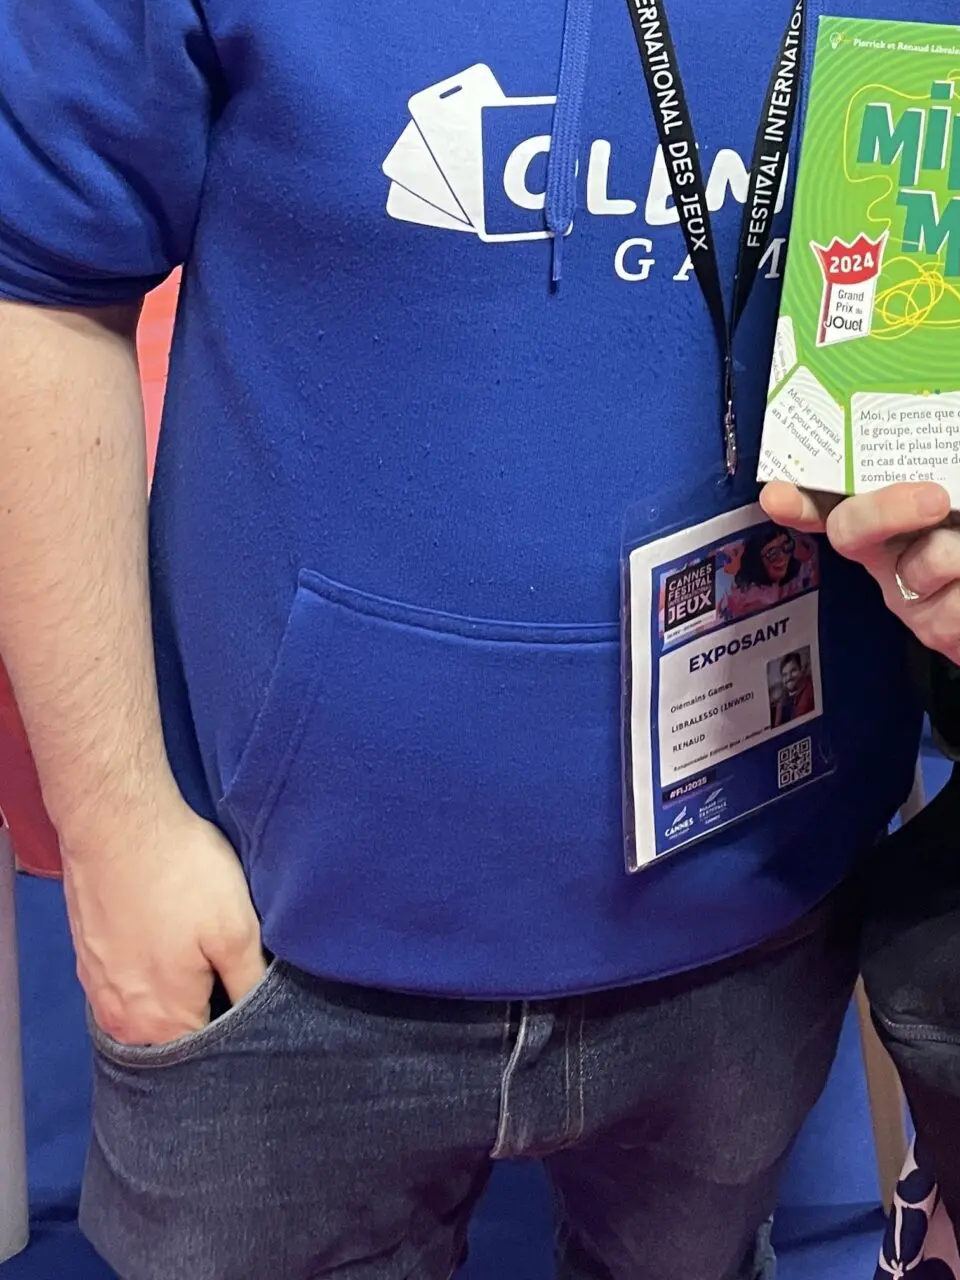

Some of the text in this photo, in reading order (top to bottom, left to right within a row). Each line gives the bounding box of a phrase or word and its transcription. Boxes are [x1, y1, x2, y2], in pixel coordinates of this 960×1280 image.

[669, 141, 695, 187] DES
[747, 151, 780, 247] FESTIVAL
[680, 193, 709, 251] JEUX
[829, 251, 874, 273] 2024
[837, 289, 864, 301] Grand
[836, 301, 853, 313] Prix
[809, 409, 841, 445] payerais
[860, 409, 884, 421] Moi,
[887, 409, 897, 422] je
[899, 410, 932, 423] pense
[934, 410, 955, 423] que
[771, 407, 820, 458] an à Poudlard
[791, 410, 811, 433] pour
[809, 425, 836, 460] étudier
[860, 424, 869, 436] le
[872, 427, 913, 438] groupe,
[916, 423, 942, 435] celui
[860, 440, 893, 451] survit
[896, 439, 906, 450] le
[908, 439, 932, 453] plus
[770, 455, 782, 468] un
[861, 457, 874, 467] en
[877, 456, 894, 466] cas
[897, 455, 948, 468] d'attaque
[860, 470, 907, 482] zombies
[909, 470, 935, 481] c'est
[669, 563, 712, 591] CANNES
[669, 575, 712, 602] FESTIVAL
[668, 589, 712, 625] JEUX
[689, 617, 790, 673] EXPOSANT
[708, 682, 734, 697] Games
[671, 707, 719, 733] LIBRALESSO
[672, 734, 706, 753] RENAUD
[664, 817, 694, 838] CANNES
